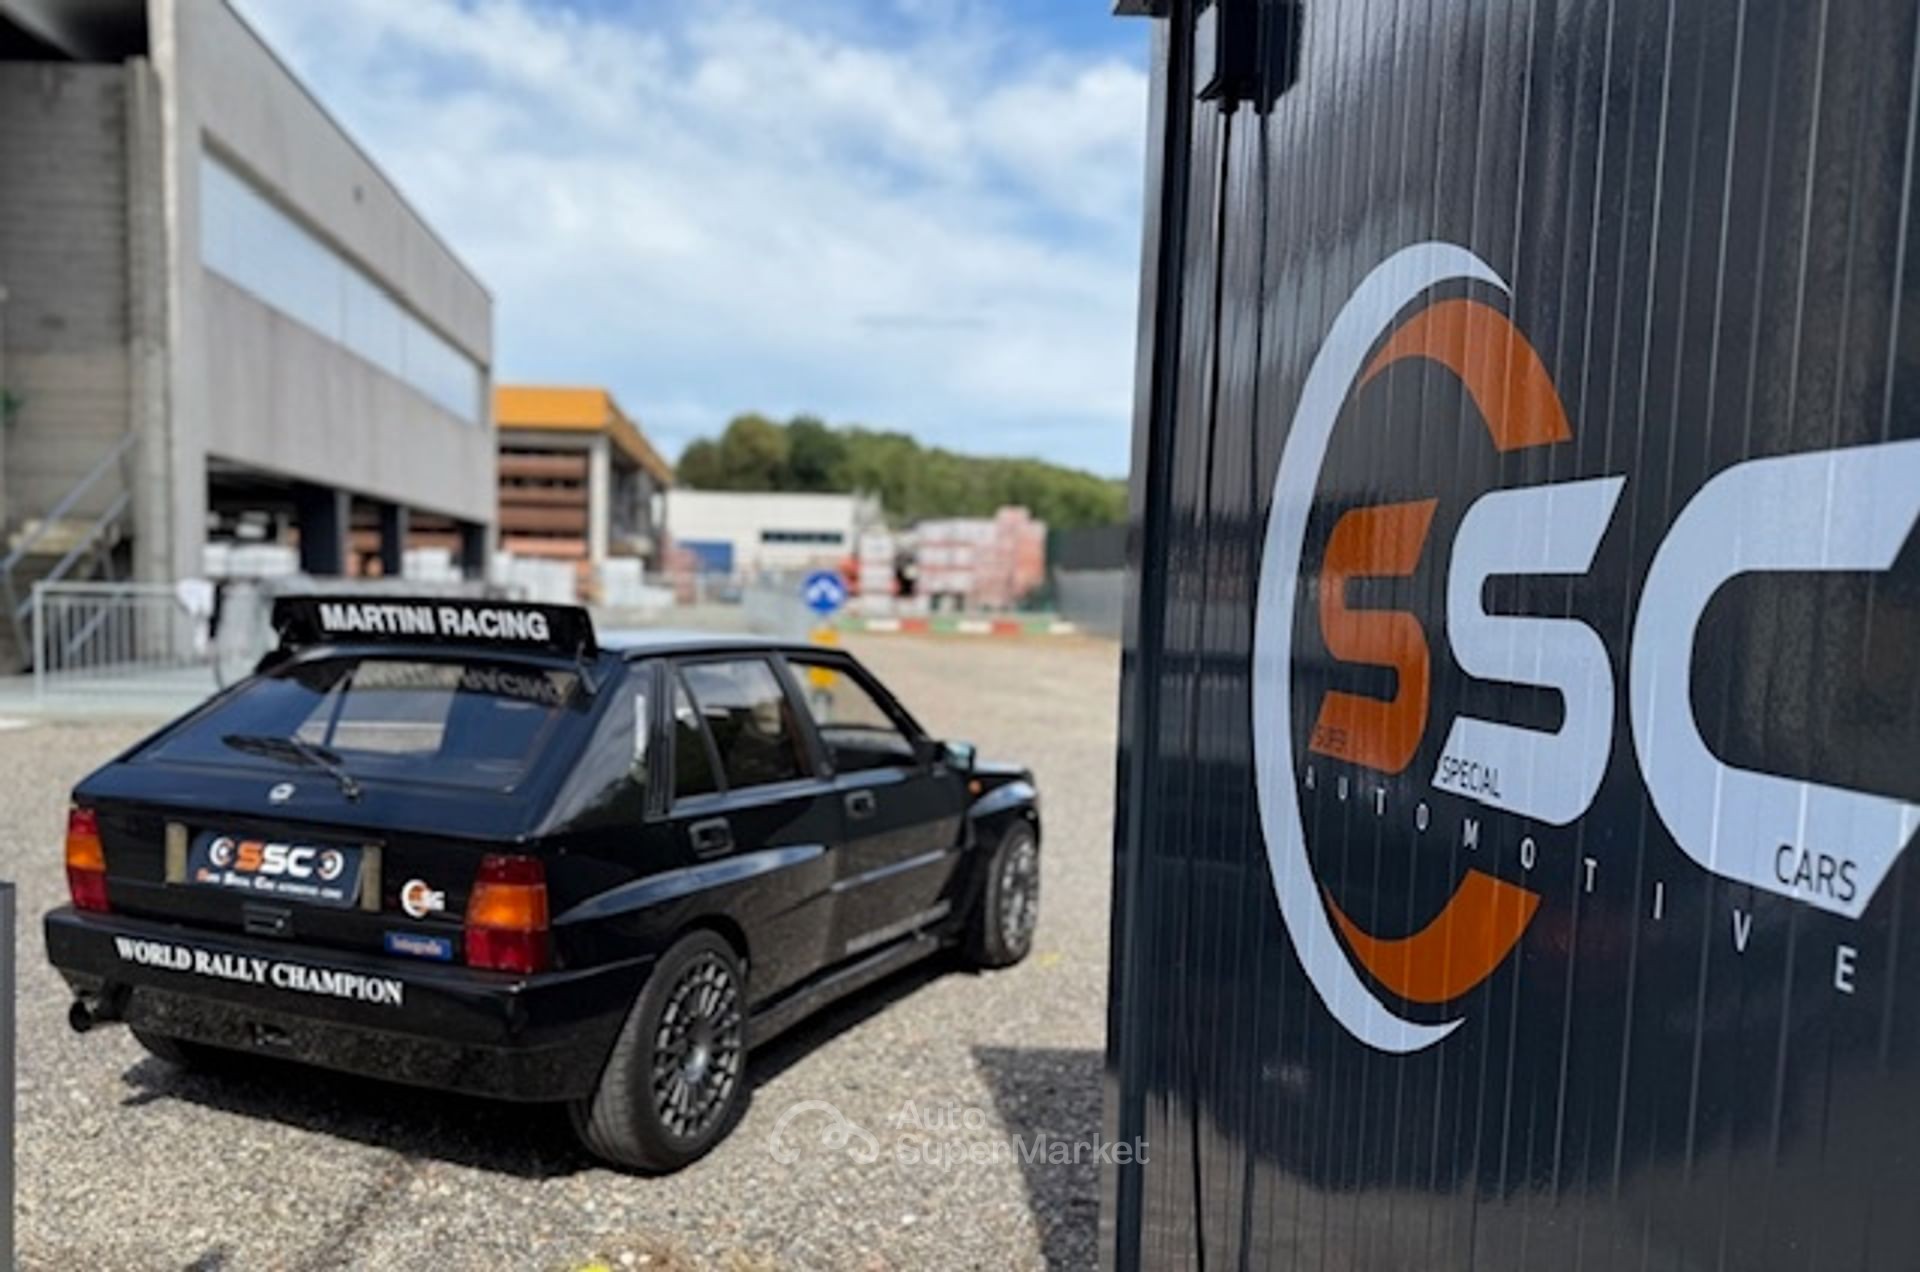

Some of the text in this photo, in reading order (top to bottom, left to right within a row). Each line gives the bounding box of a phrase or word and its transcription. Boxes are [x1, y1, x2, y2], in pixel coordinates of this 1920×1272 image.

[319, 602, 549, 641] MARTINI RACING
[1309, 439, 1920, 919] SSC
[234, 839, 317, 878] SSC
[1305, 764, 1857, 994] AUTOMOTIVE
[1441, 755, 1500, 799] SPECIAL
[1775, 844, 1858, 902] CARS
[114, 936, 404, 1007] WORLD RALLY CHAMPION
